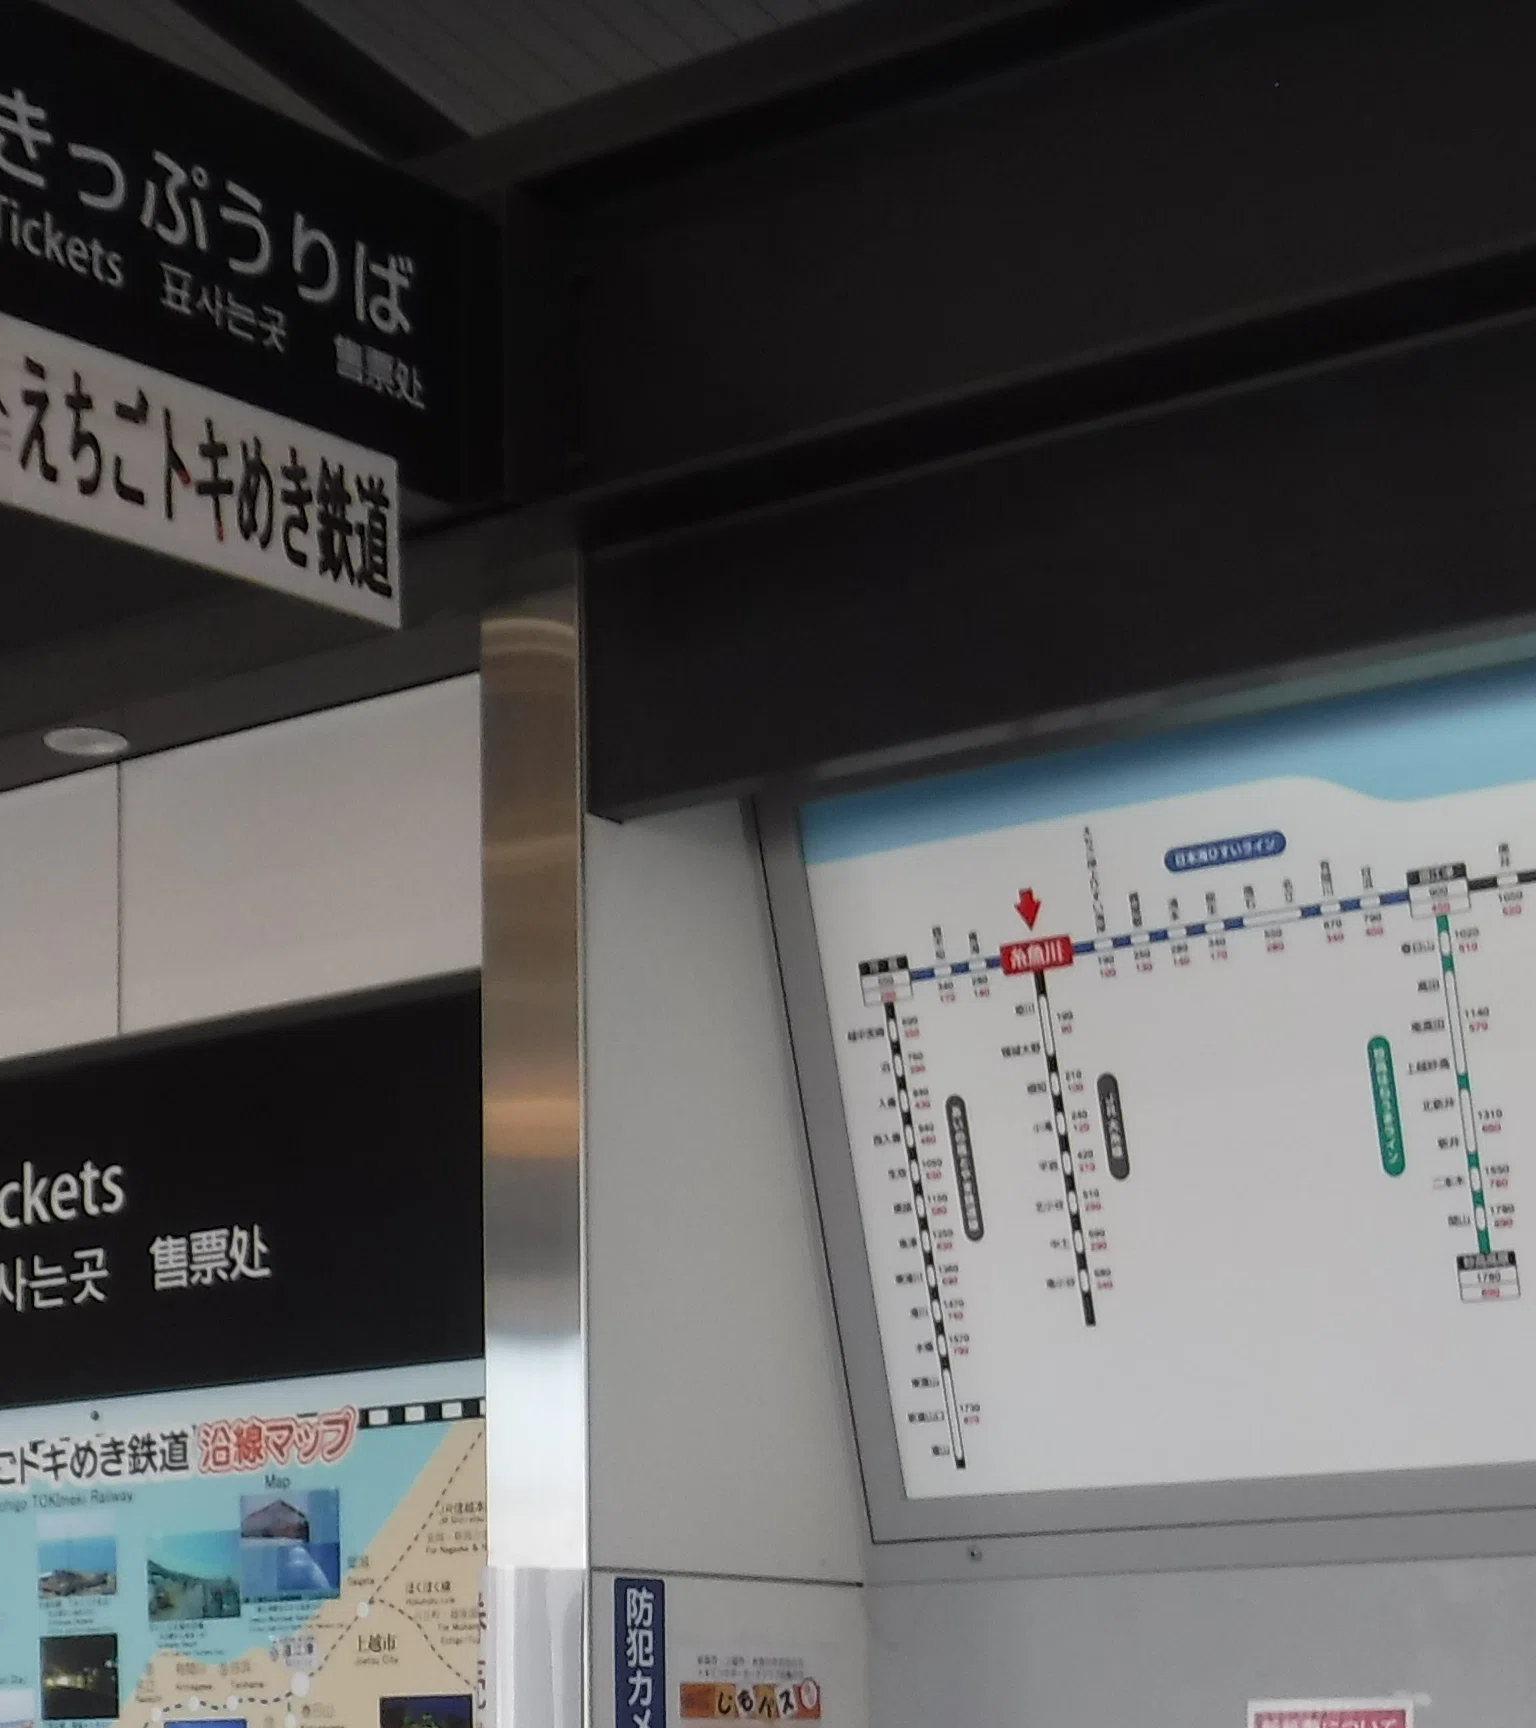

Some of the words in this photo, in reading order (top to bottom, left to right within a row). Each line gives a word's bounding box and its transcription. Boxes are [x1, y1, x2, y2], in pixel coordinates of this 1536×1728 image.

[160, 262, 289, 354] 표사는곳
[19, 355, 395, 600] えちごトキめき鉄道
[149, 1223, 272, 1292] 售票处
[200, 1408, 357, 1471] 沿線マップ
[264, 1473, 292, 1490] Map
